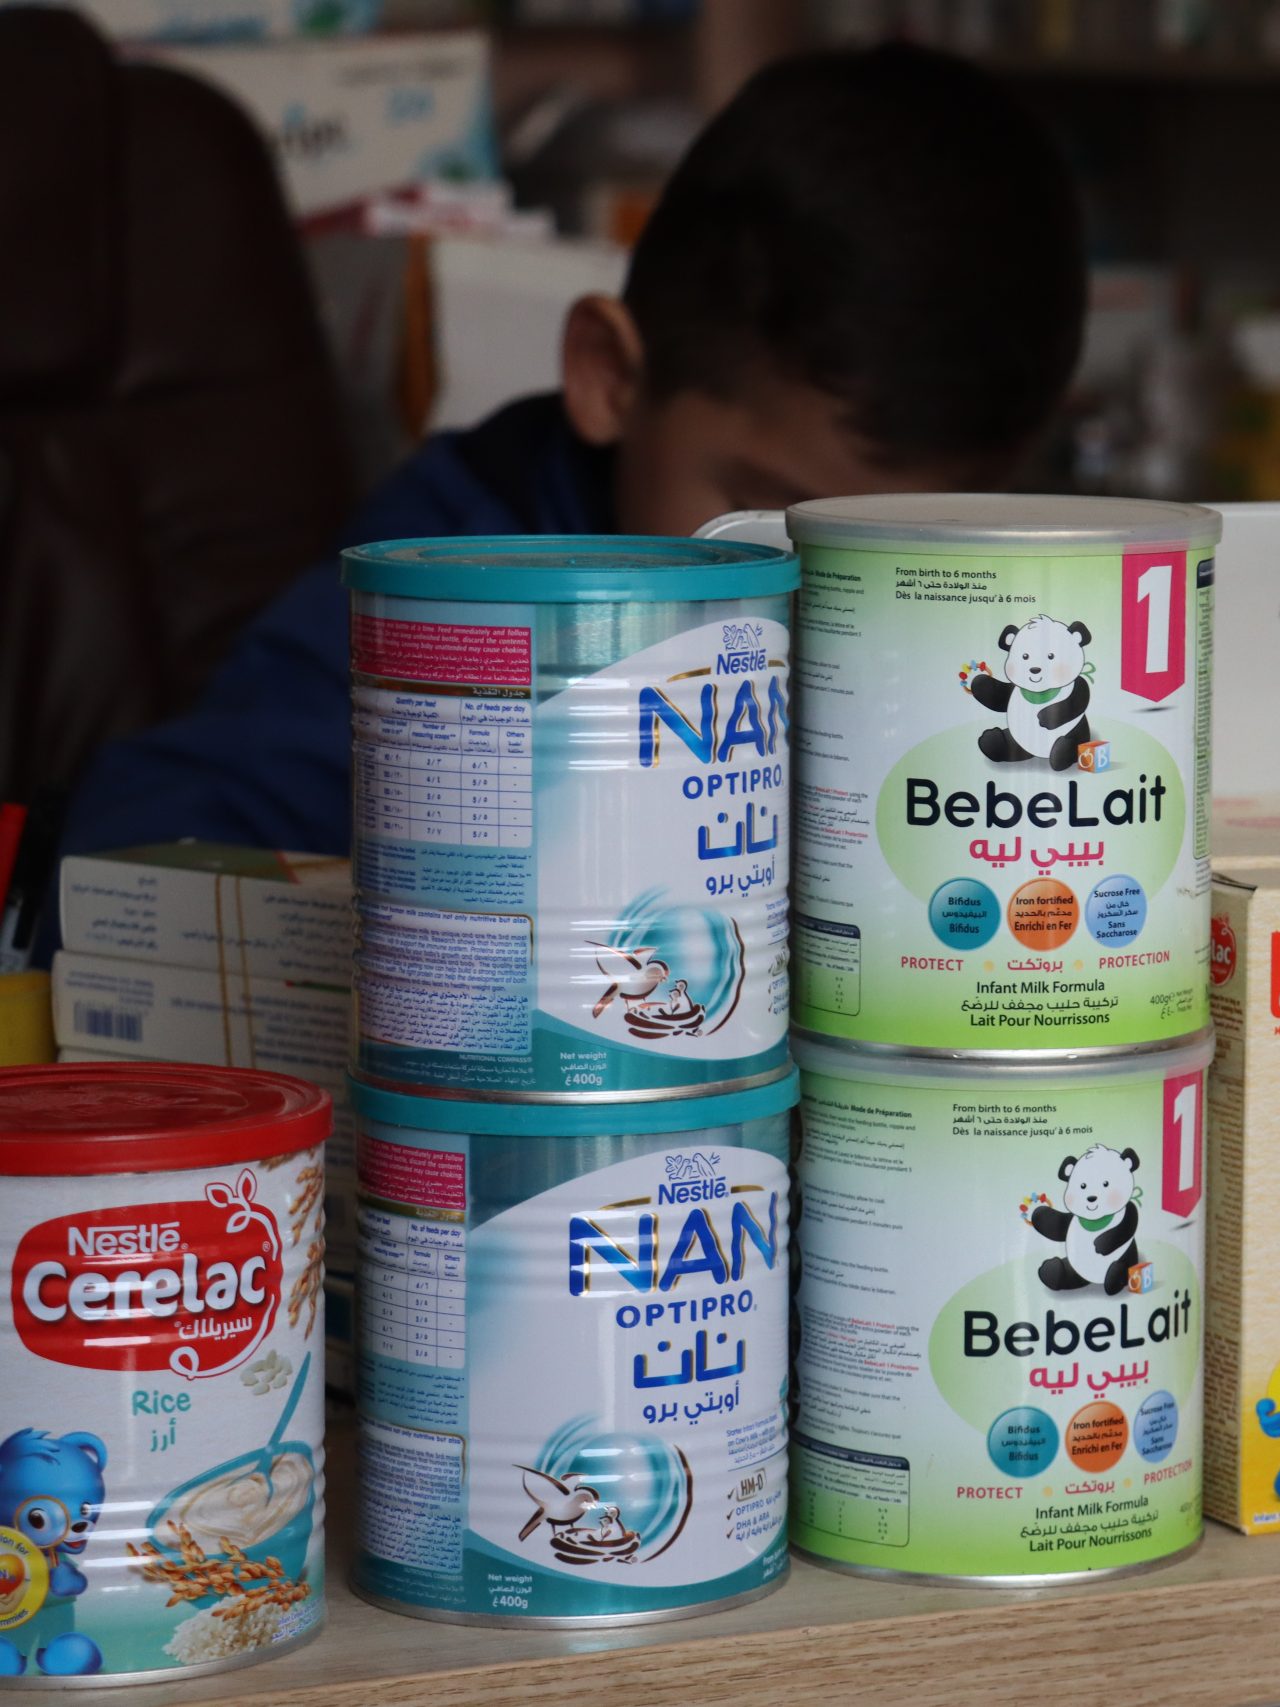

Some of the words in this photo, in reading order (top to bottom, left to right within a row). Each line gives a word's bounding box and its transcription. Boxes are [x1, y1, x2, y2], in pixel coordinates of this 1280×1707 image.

[896, 567, 917, 576] From
[919, 569, 940, 577] birth
[943, 570, 950, 578] to
[954, 570, 959, 578] 6
[962, 571, 996, 579] months
[915, 592, 922, 600] la
[924, 593, 966, 602] naissance
[1006, 595, 1011, 603] 6
[1014, 595, 1036, 603] mois
[1137, 565, 1172, 673] 1
[716, 650, 766, 676] Nestlé
[502, 704, 512, 712] per
[514, 705, 525, 713] day
[682, 764, 782, 799] OPTIPRO
[907, 774, 1166, 828] BebeLait
[969, 836, 1021, 868] ليه
[1030, 841, 1104, 875] بيبي
[706, 873, 733, 896] برو
[1094, 890, 1123, 898] Sucrose
[948, 897, 981, 906] Bifidus
[1016, 897, 1035, 905] Iron
[1037, 896, 1073, 905] fortified
[950, 923, 979, 934] Bifidus
[1015, 921, 1044, 931] Enrichi
[1059, 922, 1072, 930] Fer
[1097, 928, 1137, 939] Saccharose
[1108, 921, 1125, 929] Sans
[901, 956, 963, 972] PROTECT
[1100, 951, 1170, 970] PROTECTION
[977, 981, 1016, 994] Infant
[1021, 981, 1049, 993] Milk
[1053, 979, 1104, 993] Formula
[971, 1014, 995, 1027] Lait
[999, 1014, 1030, 1027] Pour
[1034, 1012, 1110, 1026] Nourrissons
[560, 1052, 576, 1060] Net
[578, 1052, 607, 1062] weight
[953, 1104, 976, 1112] From
[979, 1104, 1000, 1113] birth
[1015, 1105, 1020, 1113] 6
[1023, 1104, 1056, 1113] months
[953, 1127, 969, 1135] Dès
[984, 1128, 1028, 1136] naissance
[1073, 1126, 1093, 1134] mois
[1173, 1083, 1196, 1192] 1
[658, 1177, 726, 1205] Nestlé
[68, 1221, 180, 1256] Nestlé
[570, 1191, 779, 1297] NAN
[23, 1252, 266, 1322] Cerelac
[616, 1289, 753, 1329] OPTIPRO
[178, 1317, 252, 1341] سيريلاك
[964, 1289, 1191, 1357] BebeLait
[634, 1330, 745, 1389] نان
[1029, 1362, 1079, 1394] ليه
[1087, 1360, 1149, 1398] بيبي
[132, 1390, 191, 1416] Rice
[643, 1401, 677, 1424] برو
[685, 1381, 740, 1425] أوبتي
[1008, 1425, 1040, 1434] Bifidus
[1074, 1421, 1090, 1429] Iron
[1093, 1416, 1124, 1428] fortified
[1009, 1452, 1038, 1462] Bifidus
[1072, 1444, 1098, 1456] Enrichi
[1101, 1445, 1109, 1453] en
[1111, 1442, 1122, 1451] Fer
[1145, 1459, 1193, 1485] PROTECTION
[957, 1487, 1023, 1499] PROTECT
[1036, 1506, 1073, 1519] Infant
[1078, 1501, 1102, 1517] Milk
[1106, 1495, 1148, 1513] Formula
[1030, 1536, 1053, 1552] Lait
[1058, 1537, 1085, 1550] Pour
[1089, 1528, 1152, 1548] Nourrissons
[488, 1574, 502, 1582] Net
[505, 1575, 533, 1584] weight
